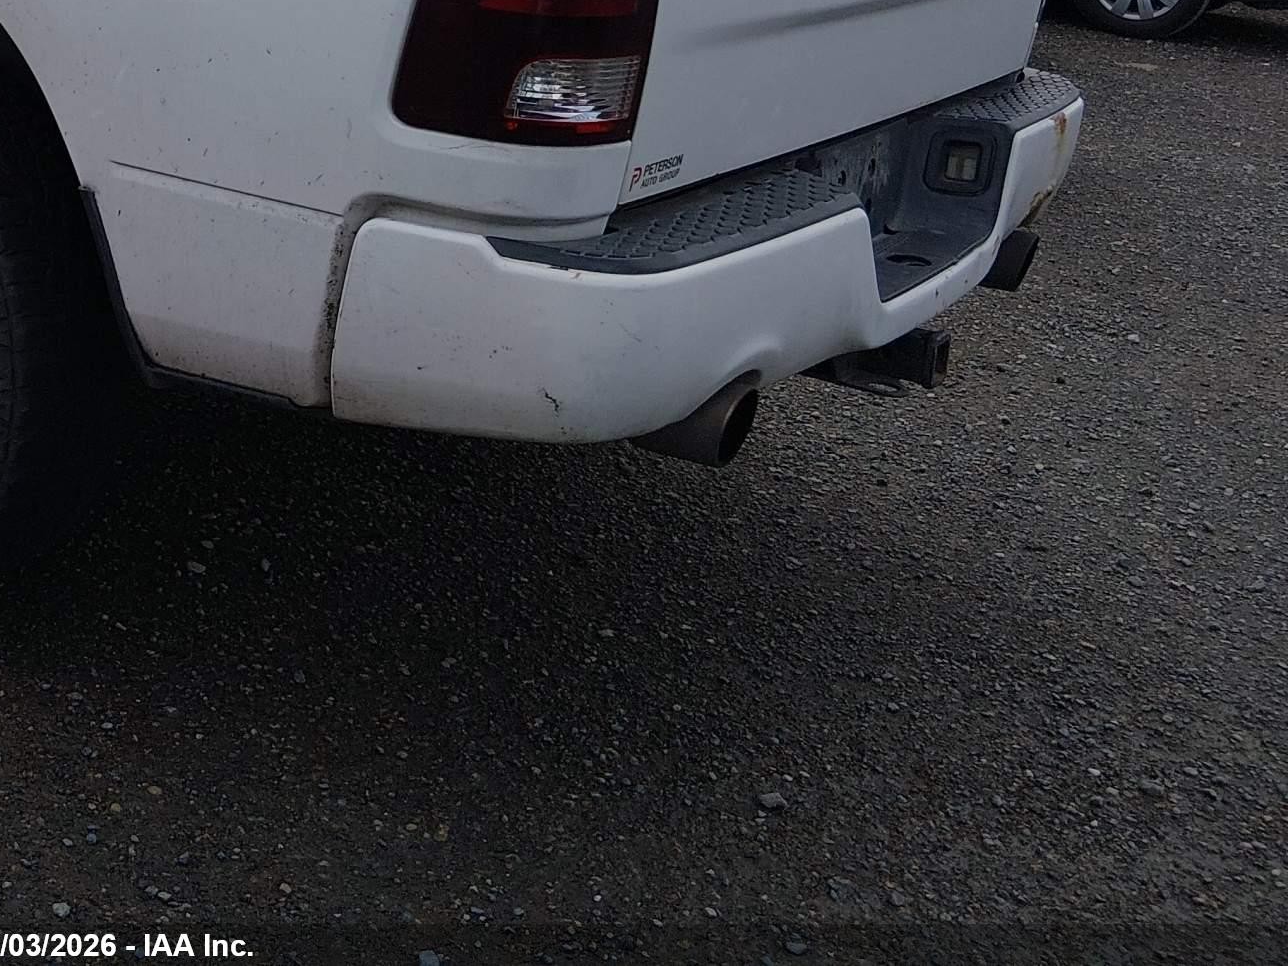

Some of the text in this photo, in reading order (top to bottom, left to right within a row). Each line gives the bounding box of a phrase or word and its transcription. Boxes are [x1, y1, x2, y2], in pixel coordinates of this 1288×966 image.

[643, 154, 684, 176] PETERSON
[641, 168, 680, 187] AUTO GROUP
